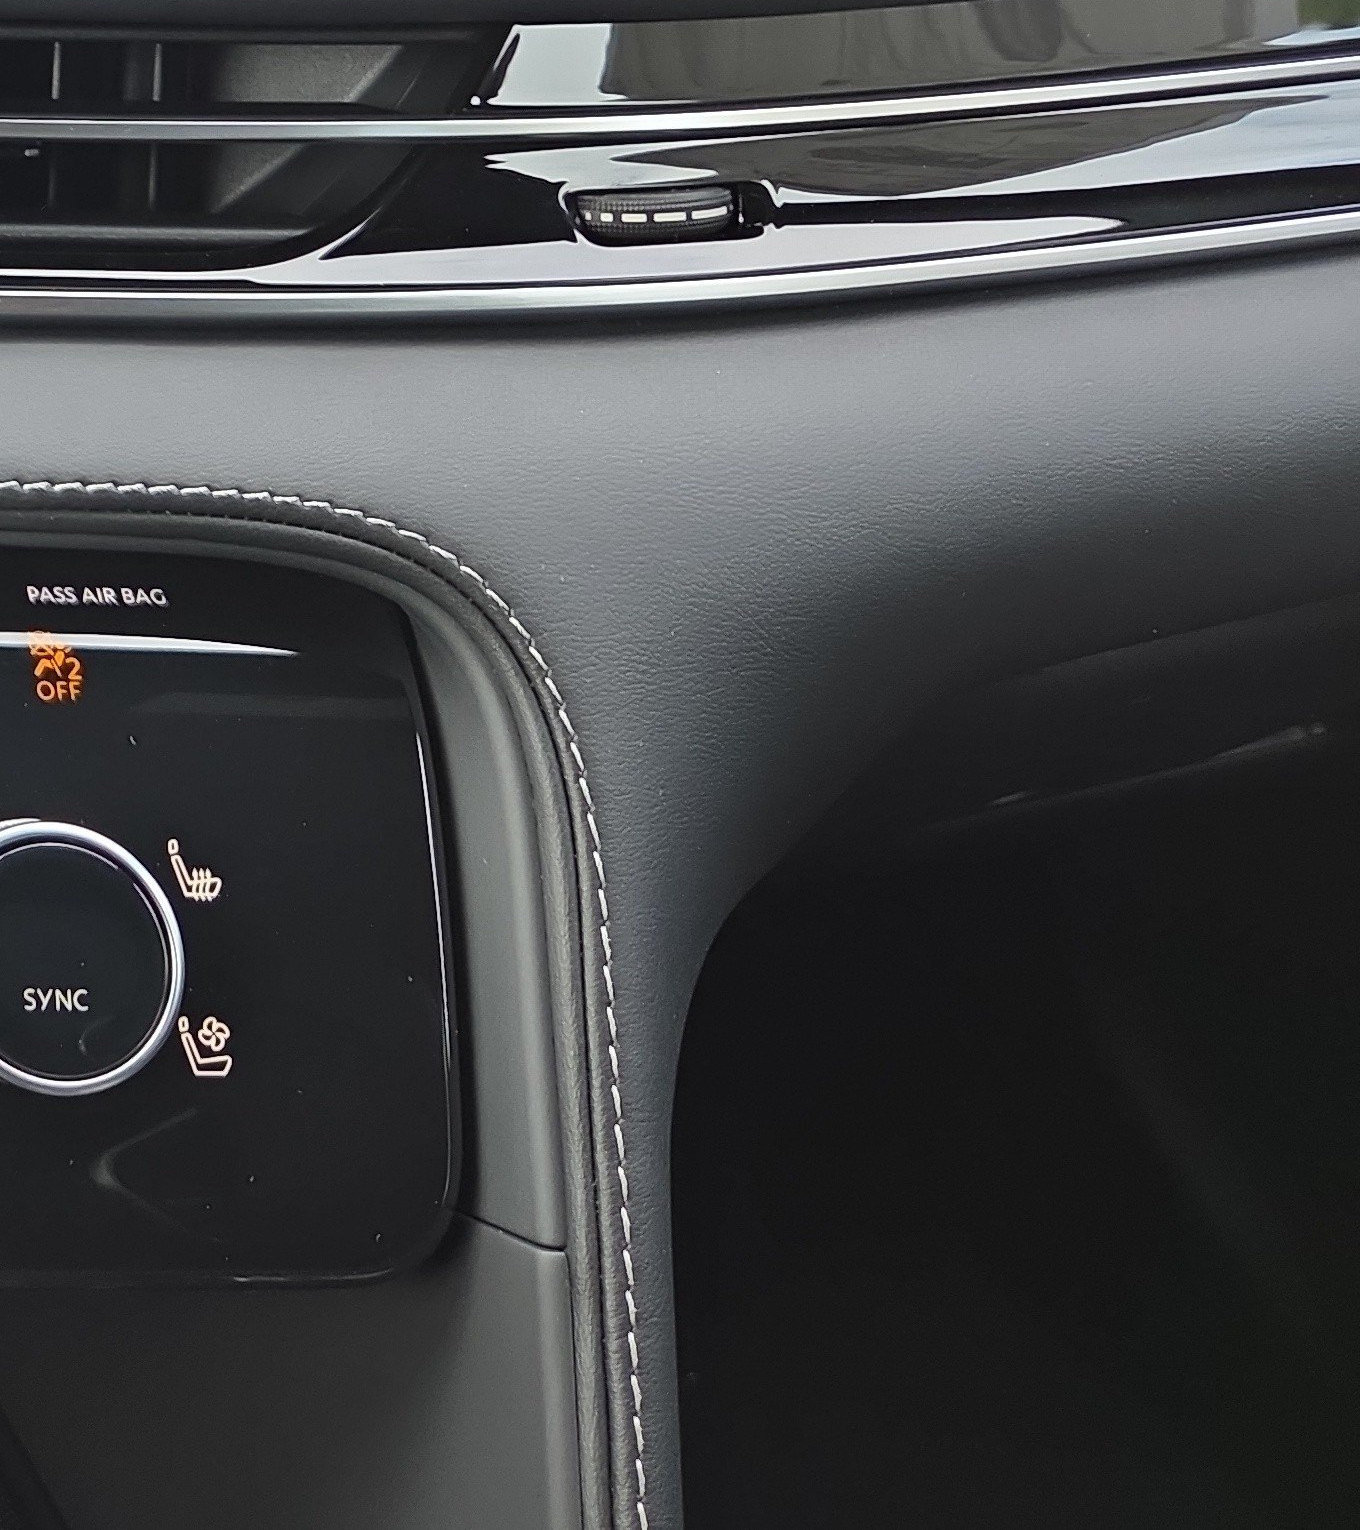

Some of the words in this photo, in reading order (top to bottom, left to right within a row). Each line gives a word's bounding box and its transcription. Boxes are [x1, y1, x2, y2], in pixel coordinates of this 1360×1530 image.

[26, 585, 79, 606] PASS
[82, 586, 119, 606] AIR
[120, 587, 169, 608] BAG
[36, 679, 81, 702] OFF
[22, 988, 90, 1012] SYNC
